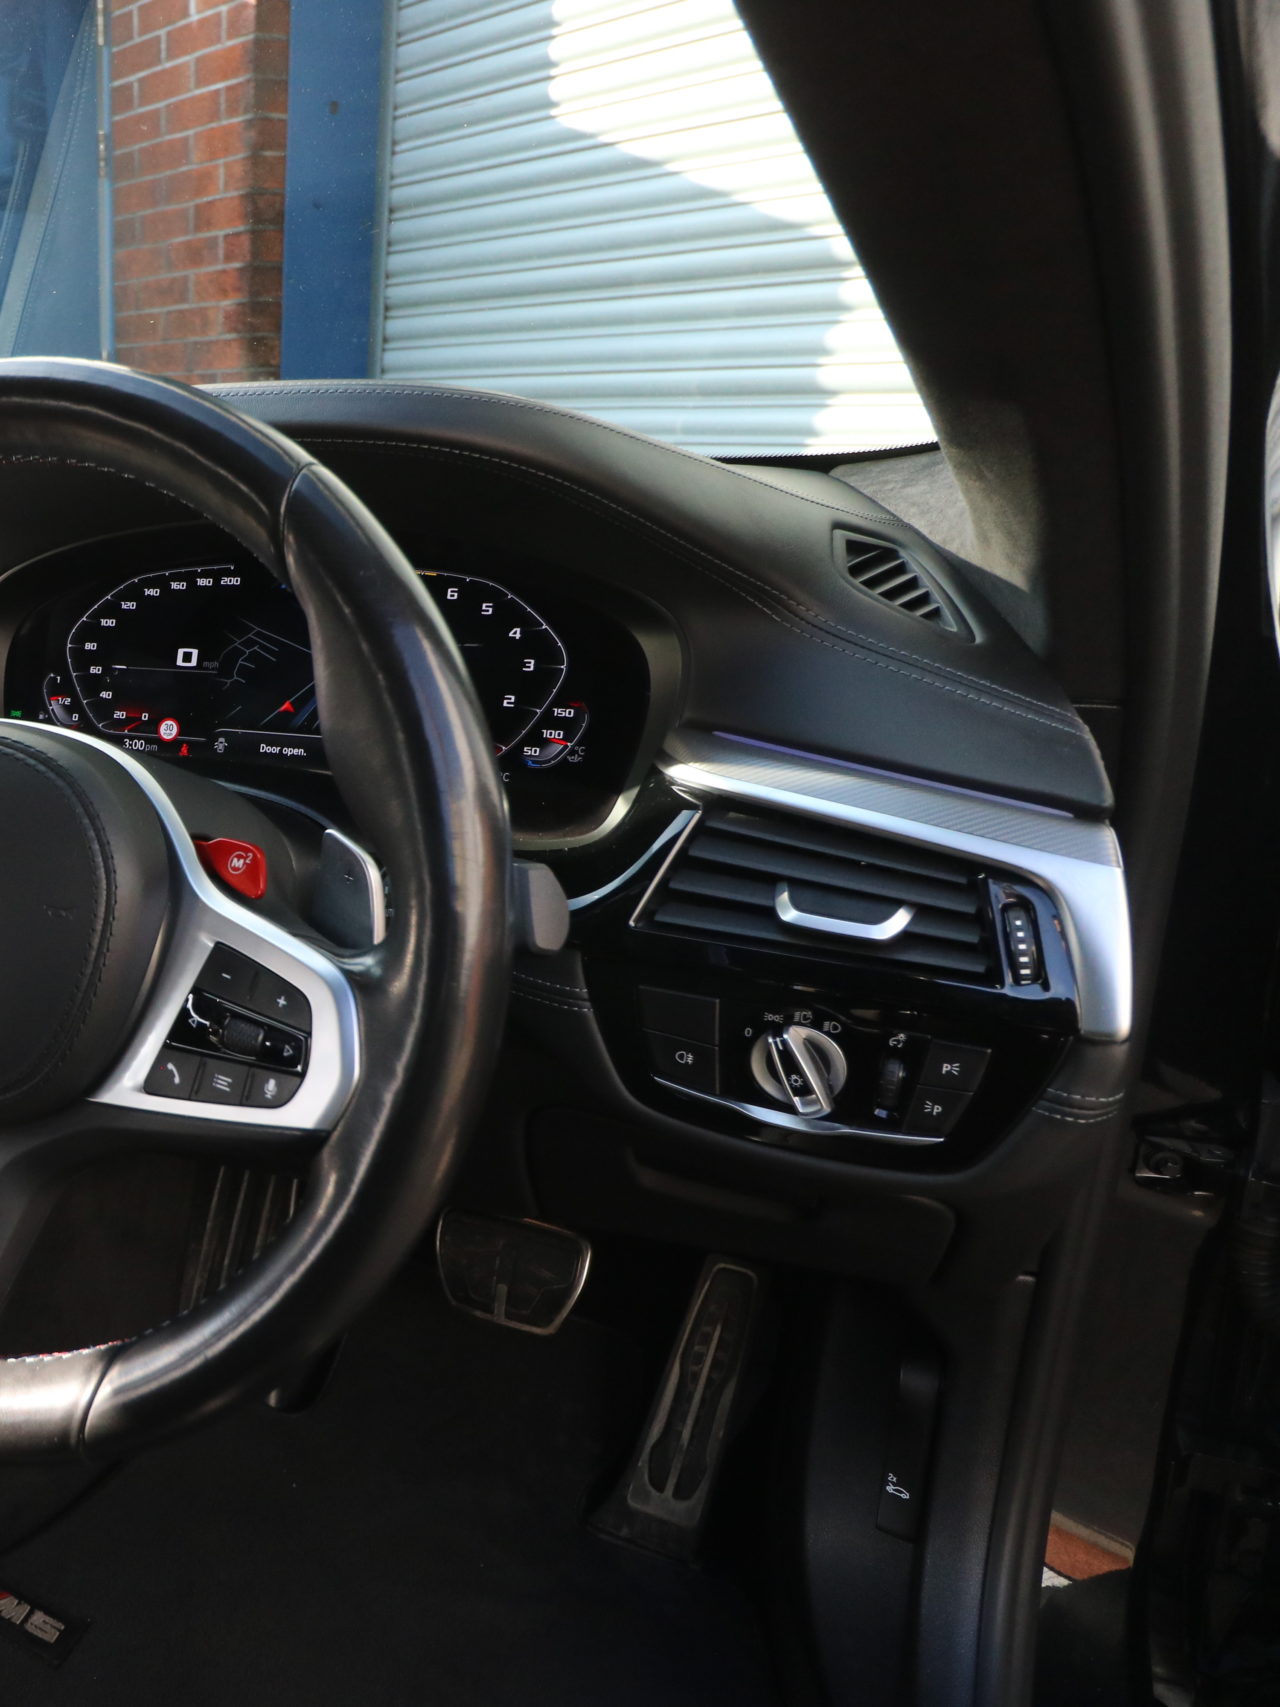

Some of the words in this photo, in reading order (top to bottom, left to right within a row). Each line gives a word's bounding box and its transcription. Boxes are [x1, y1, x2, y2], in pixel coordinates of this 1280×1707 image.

[196, 578, 213, 586] 180
[221, 577, 240, 585] 200
[170, 582, 186, 590] 160
[144, 588, 160, 596] 140
[447, 588, 459, 600] 6
[121, 601, 136, 610] 120
[481, 603, 493, 615] 5
[100, 618, 116, 627] 100
[508, 628, 521, 640] 4
[84, 642, 97, 650] 80
[176, 648, 199, 667] 0
[202, 660, 219, 669] mph
[522, 659, 535, 671] 3
[89, 666, 102, 674] 60
[100, 691, 112, 699] 40
[57, 697, 71, 705] 1/2
[503, 695, 515, 707] 2
[113, 711, 126, 719] 20
[141, 713, 149, 721] 0
[553, 708, 574, 717] 150
[163, 723, 174, 732] 30
[541, 729, 564, 739] 100
[123, 738, 145, 751] 3:00
[145, 744, 158, 752] pm
[260, 743, 280, 754] Door
[282, 747, 307, 757] open.
[523, 747, 540, 756] 50
